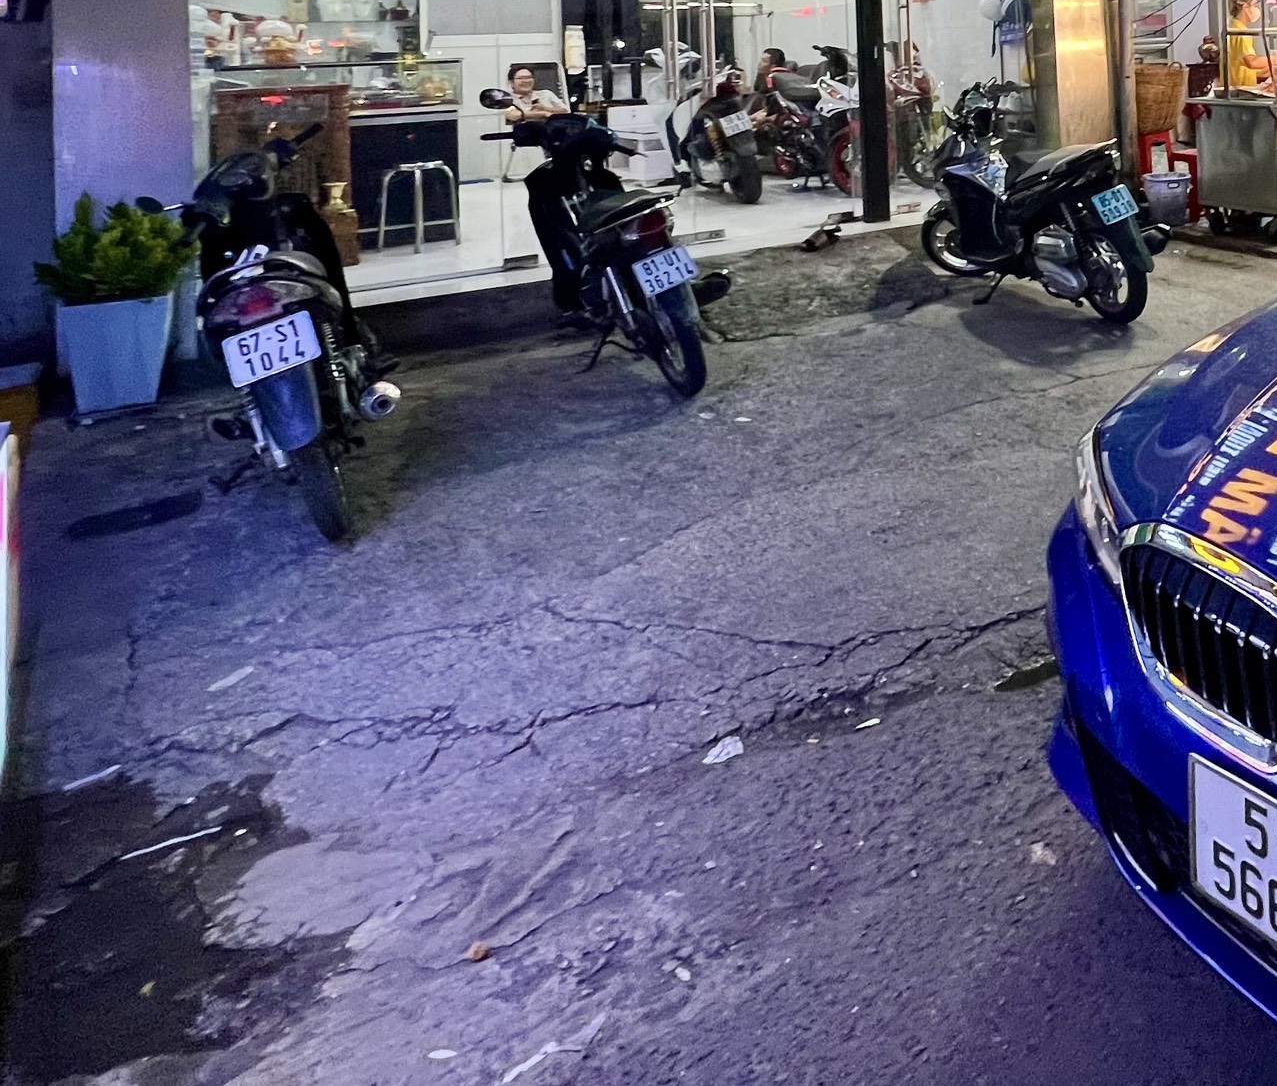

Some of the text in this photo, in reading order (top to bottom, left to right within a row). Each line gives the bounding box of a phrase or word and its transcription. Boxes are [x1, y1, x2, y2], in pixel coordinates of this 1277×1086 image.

[641, 250, 681, 276] 81-U1
[236, 319, 299, 356] 67-S1
[244, 339, 306, 377] 1044
